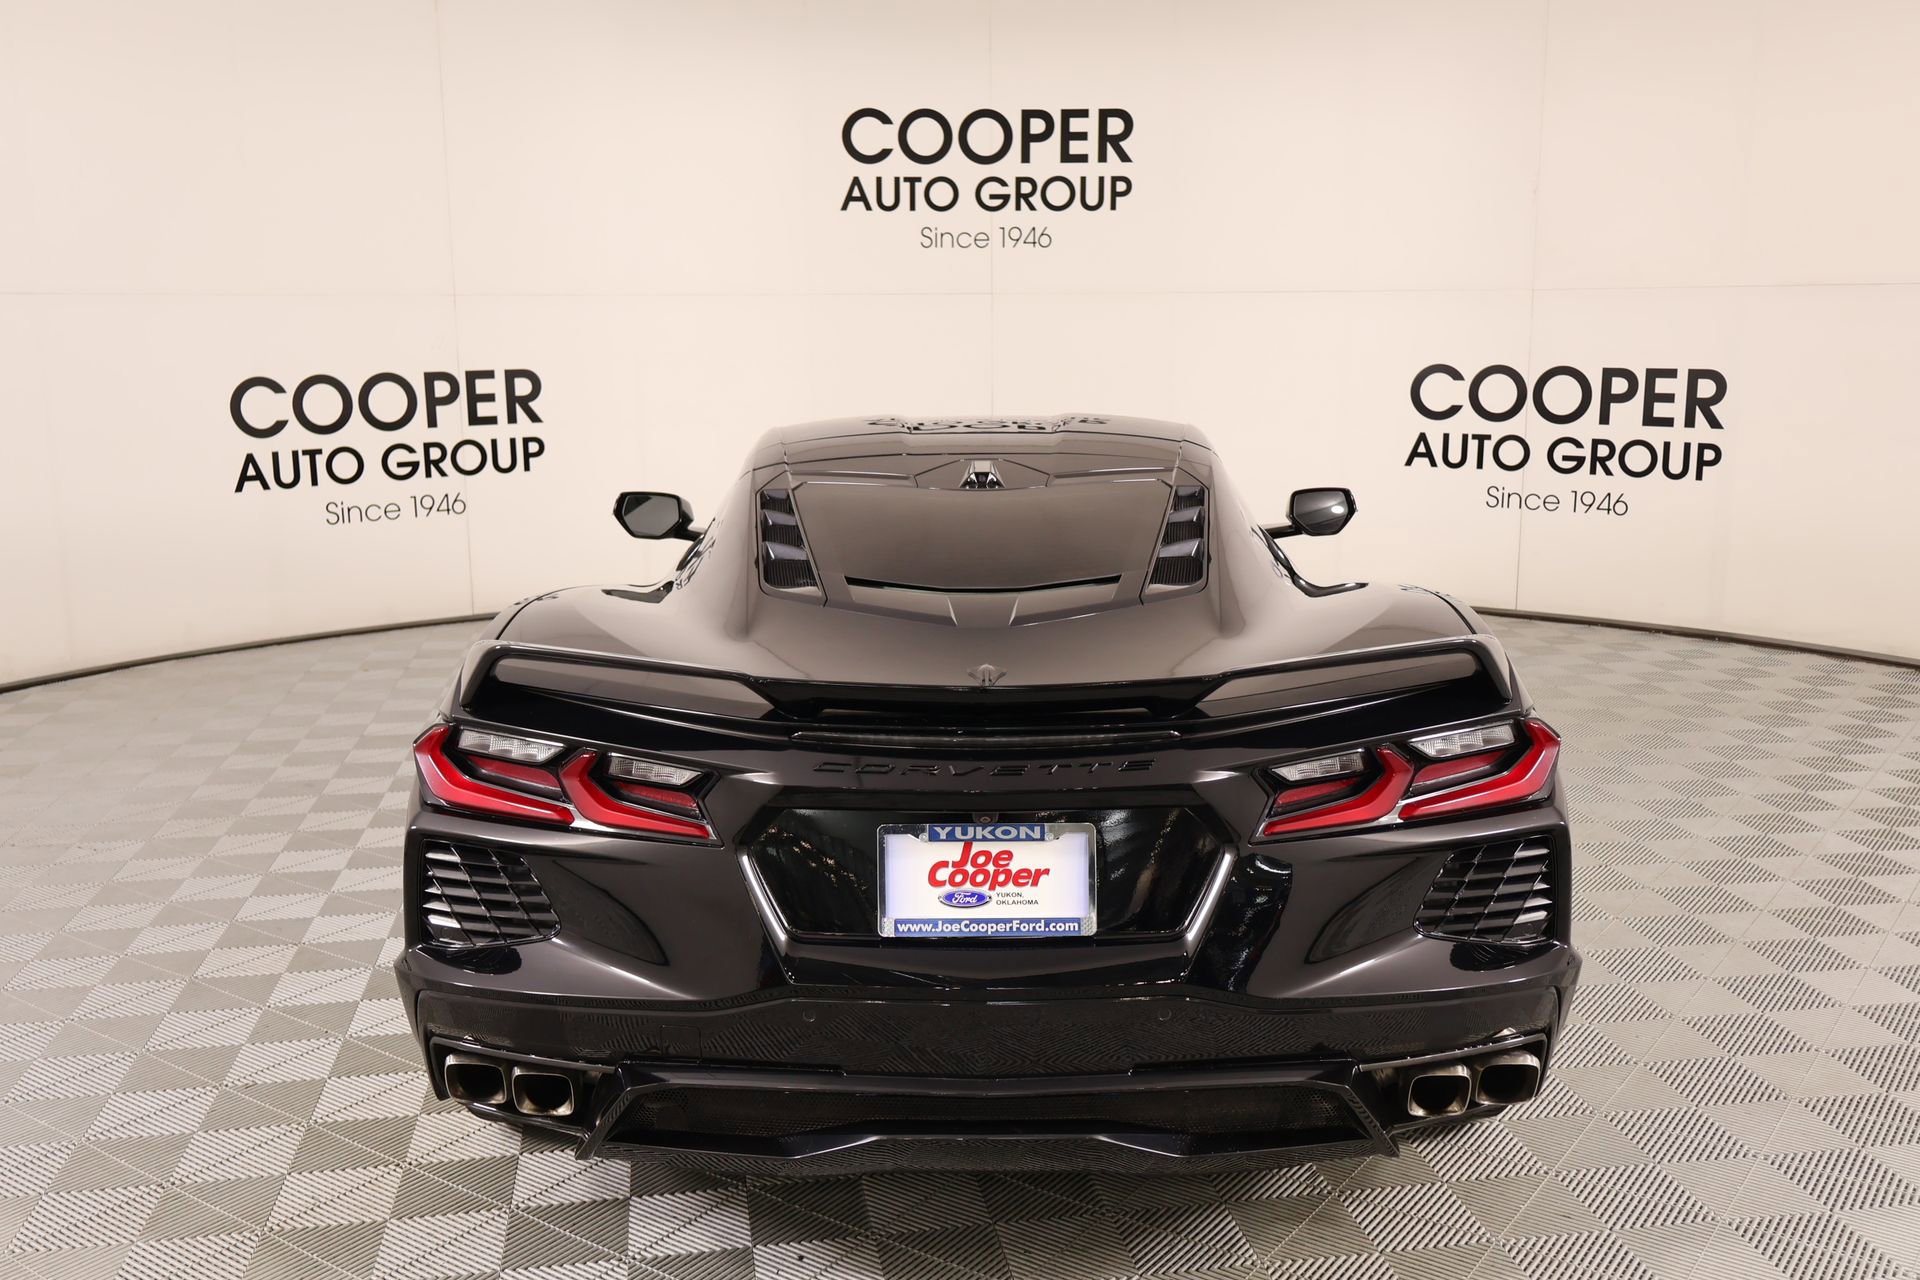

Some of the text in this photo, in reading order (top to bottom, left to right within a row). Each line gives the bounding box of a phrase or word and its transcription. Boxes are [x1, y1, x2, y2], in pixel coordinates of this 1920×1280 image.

[842, 108, 1135, 165] COOPER
[840, 175, 1133, 213] AUTO GROUP
[920, 226, 1053, 249] Since 1946
[230, 368, 544, 439] COOPER
[1410, 363, 1728, 430] COOPER
[234, 436, 546, 493] AUTO GROUP
[1404, 432, 1723, 482] AUTO GROUP
[325, 492, 467, 526] Since 1946
[1485, 486, 1629, 516] Since 1946
[813, 758, 1156, 776] CORVETTE
[933, 825, 1041, 840] YUKON
[951, 841, 1014, 868] Joe
[928, 860, 1050, 890] Cooper
[951, 891, 978, 904] Ford
[897, 919, 1079, 935] www.JoeCooperFord.com
